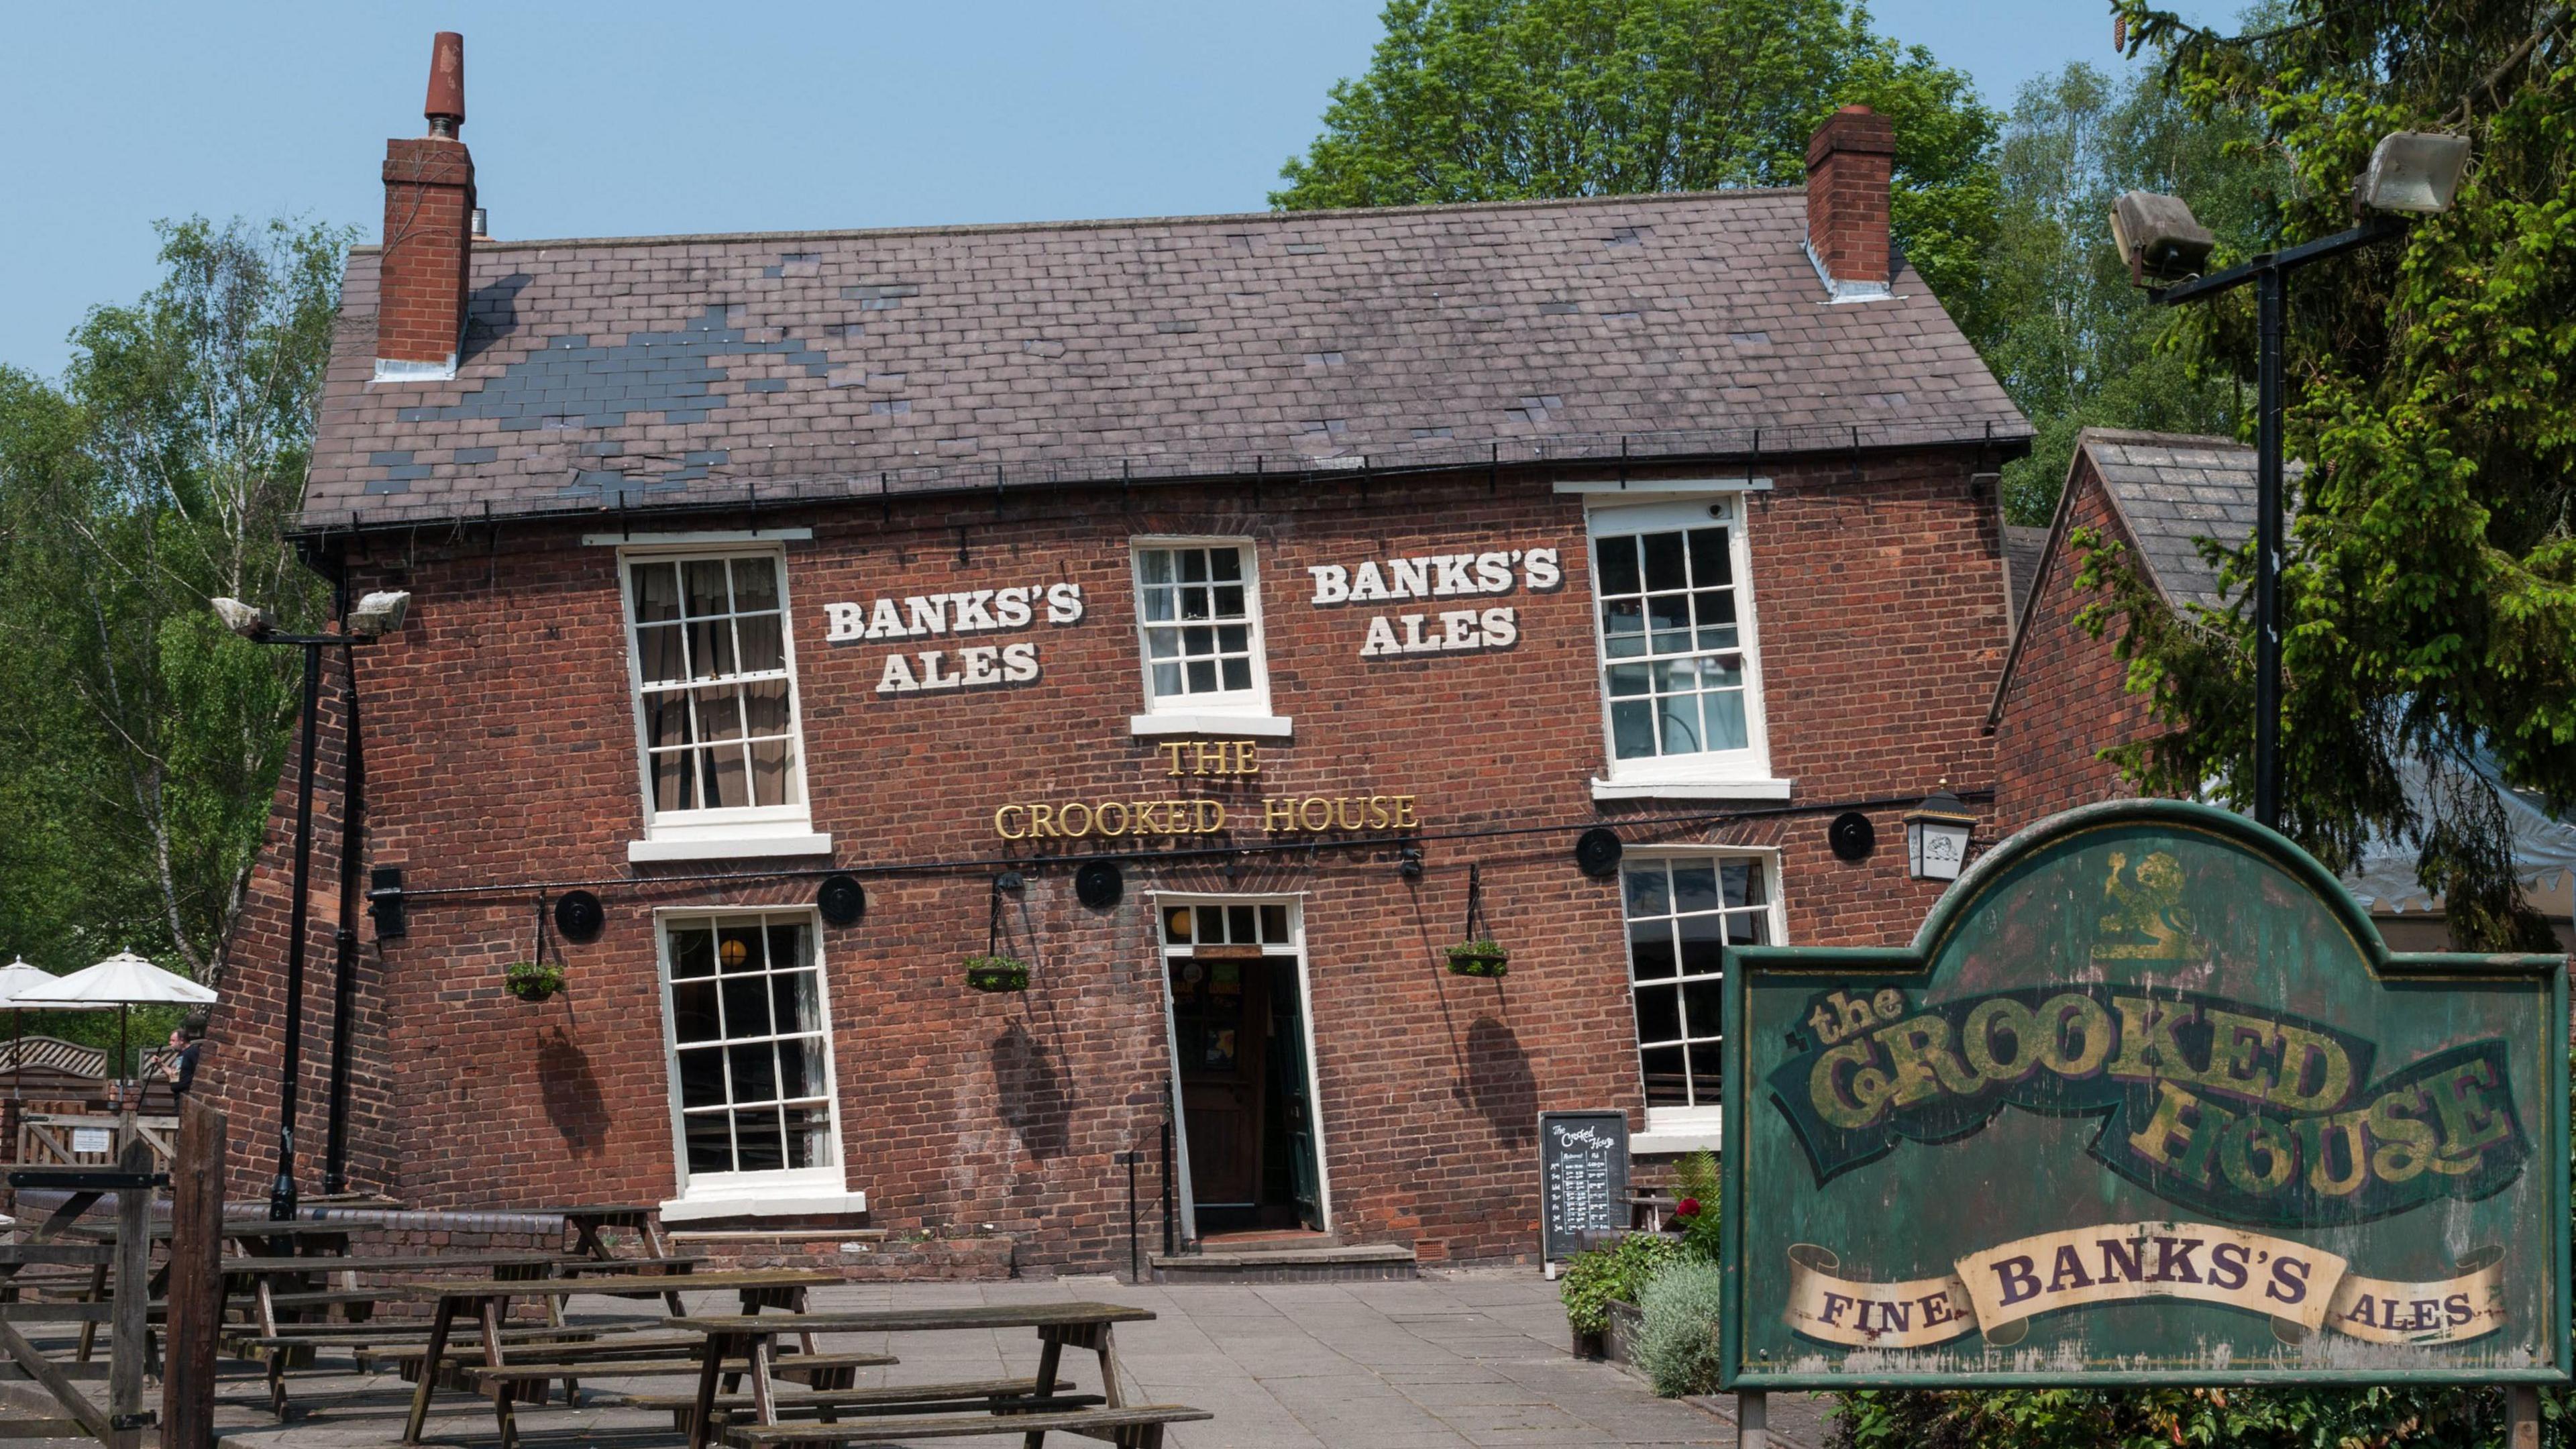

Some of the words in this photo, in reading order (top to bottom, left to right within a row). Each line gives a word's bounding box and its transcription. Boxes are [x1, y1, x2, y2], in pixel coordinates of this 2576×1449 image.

[1308, 547, 1561, 605] BANKS'S
[824, 582, 1084, 642] BANKS'S
[1360, 606, 1518, 657] ALES
[875, 642, 1040, 693] ALES
[1159, 740, 1260, 776] THE
[994, 800, 1226, 840] CROOKED
[1262, 795, 1419, 833] HOUSE
[1806, 986, 1904, 1046] the
[1809, 993, 2353, 1130] CROOKED
[1552, 1124, 1566, 1135] The
[2128, 1057, 2512, 1197] HOUSE
[1817, 1291, 1952, 1333] FINE
[1990, 1236, 2313, 1307] BANKS'S
[2349, 1293, 2473, 1332] ALES
